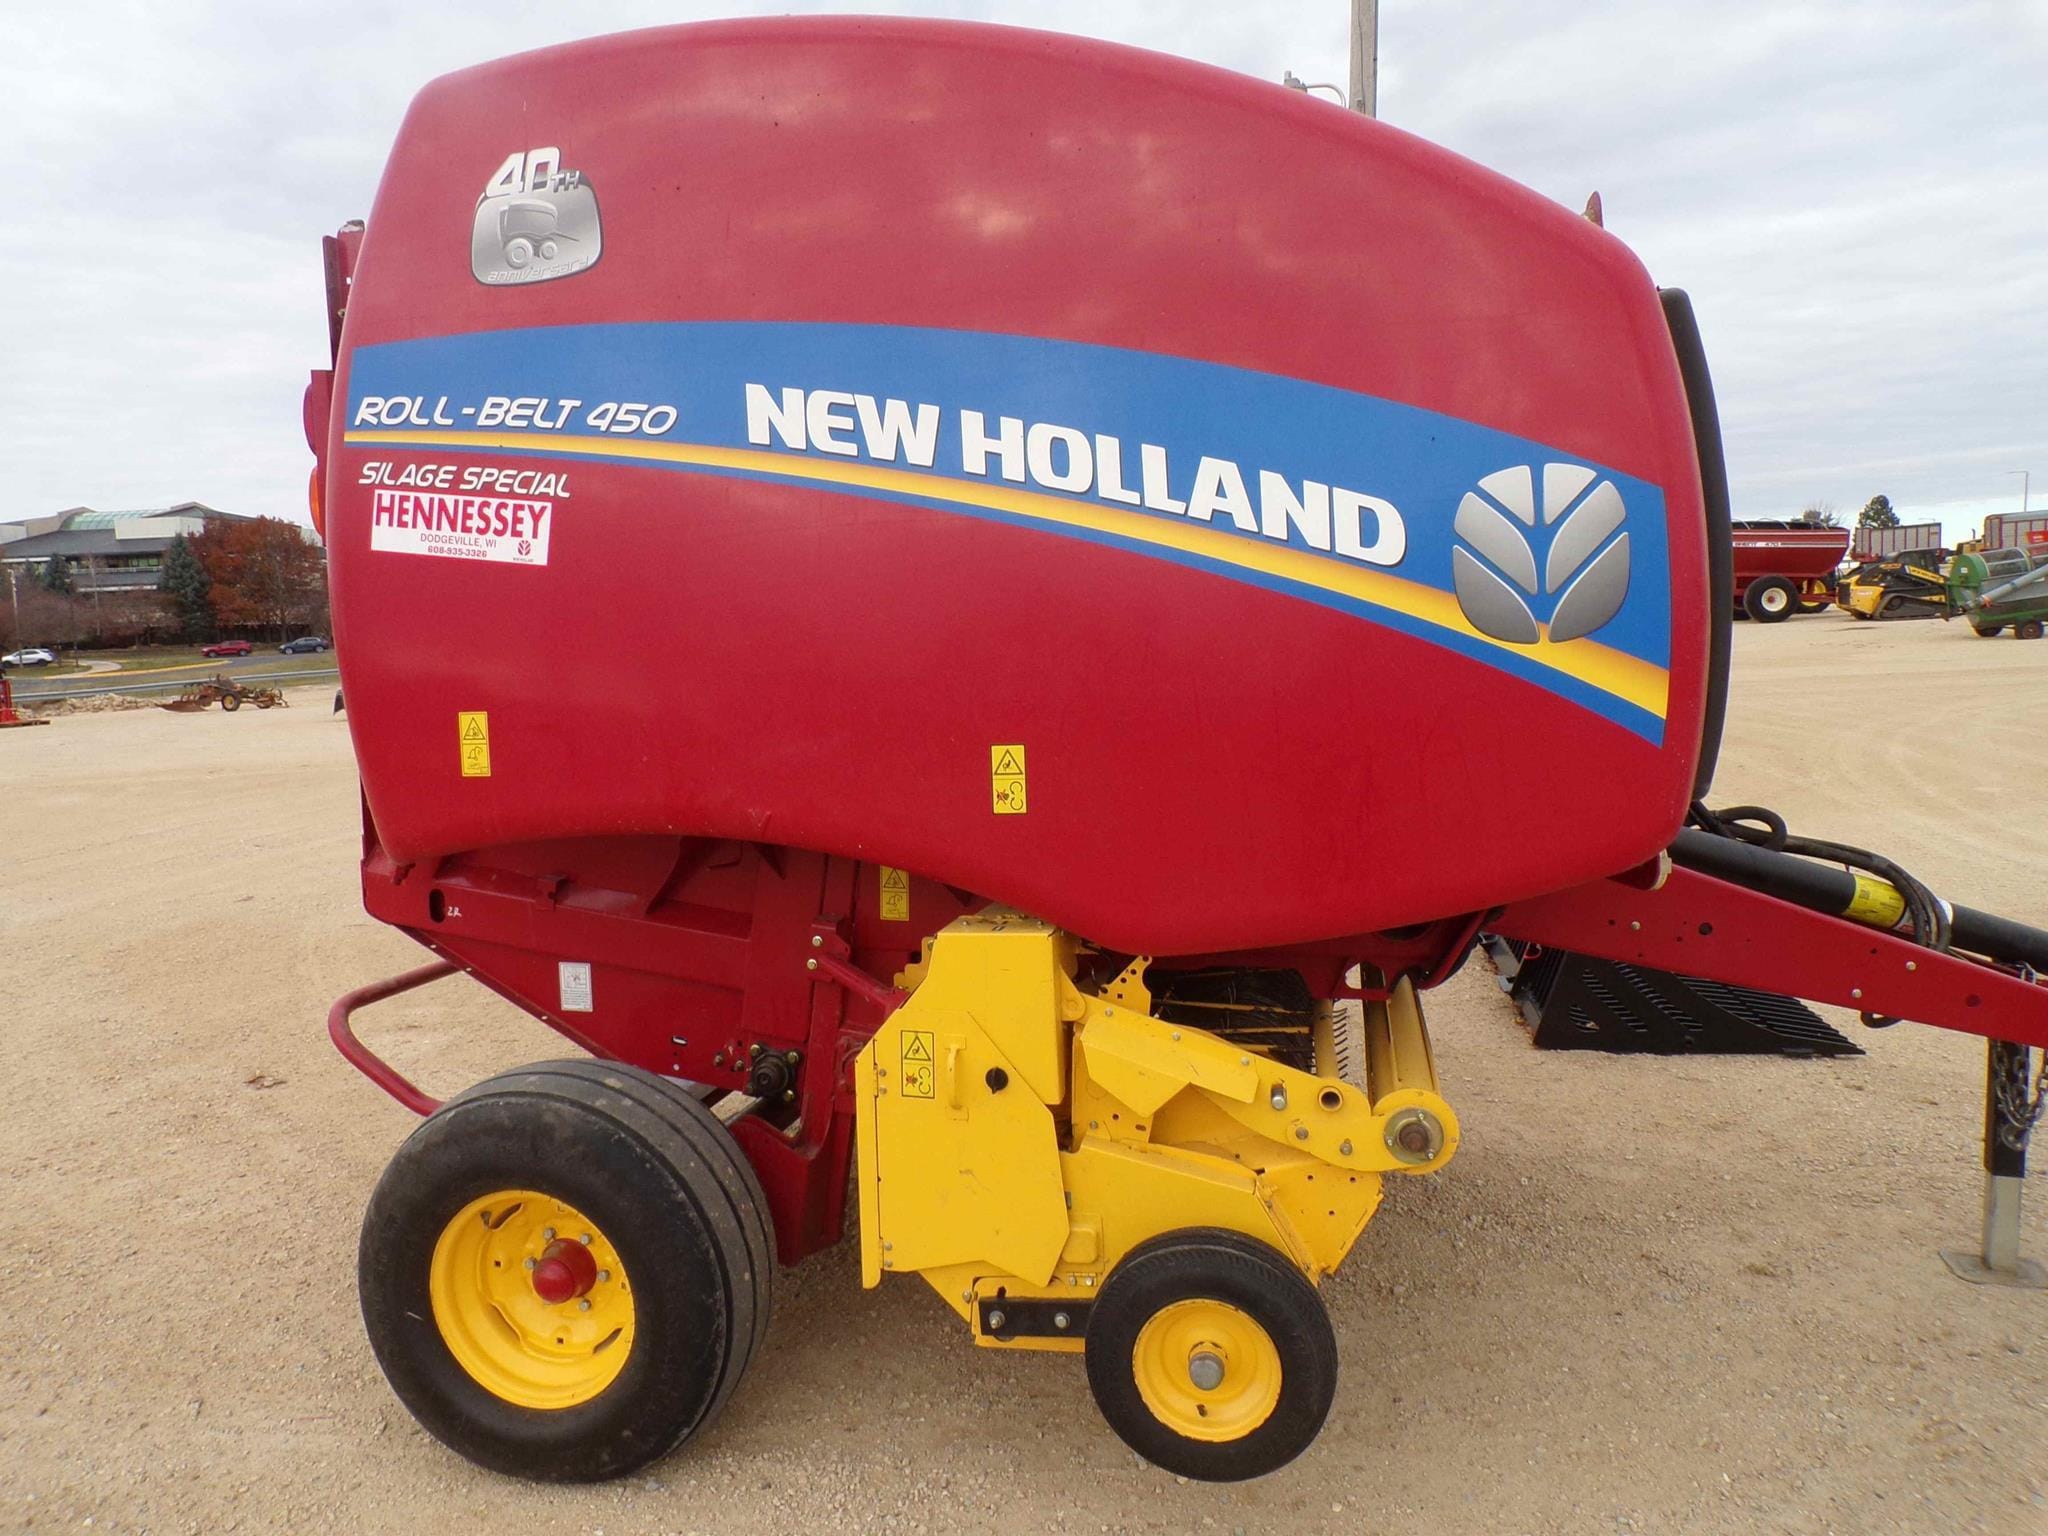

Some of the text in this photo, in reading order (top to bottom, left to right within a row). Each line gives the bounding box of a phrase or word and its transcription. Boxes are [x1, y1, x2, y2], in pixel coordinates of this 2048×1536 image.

[586, 402, 677, 435] 450
[358, 462, 571, 498] SILAGE SPECIAL
[745, 382, 1407, 567] NEW HOLLAND
[375, 493, 548, 540] HENNESSEY
[427, 545, 488, 558] 608-935-3326
[485, 538, 497, 548] WI
